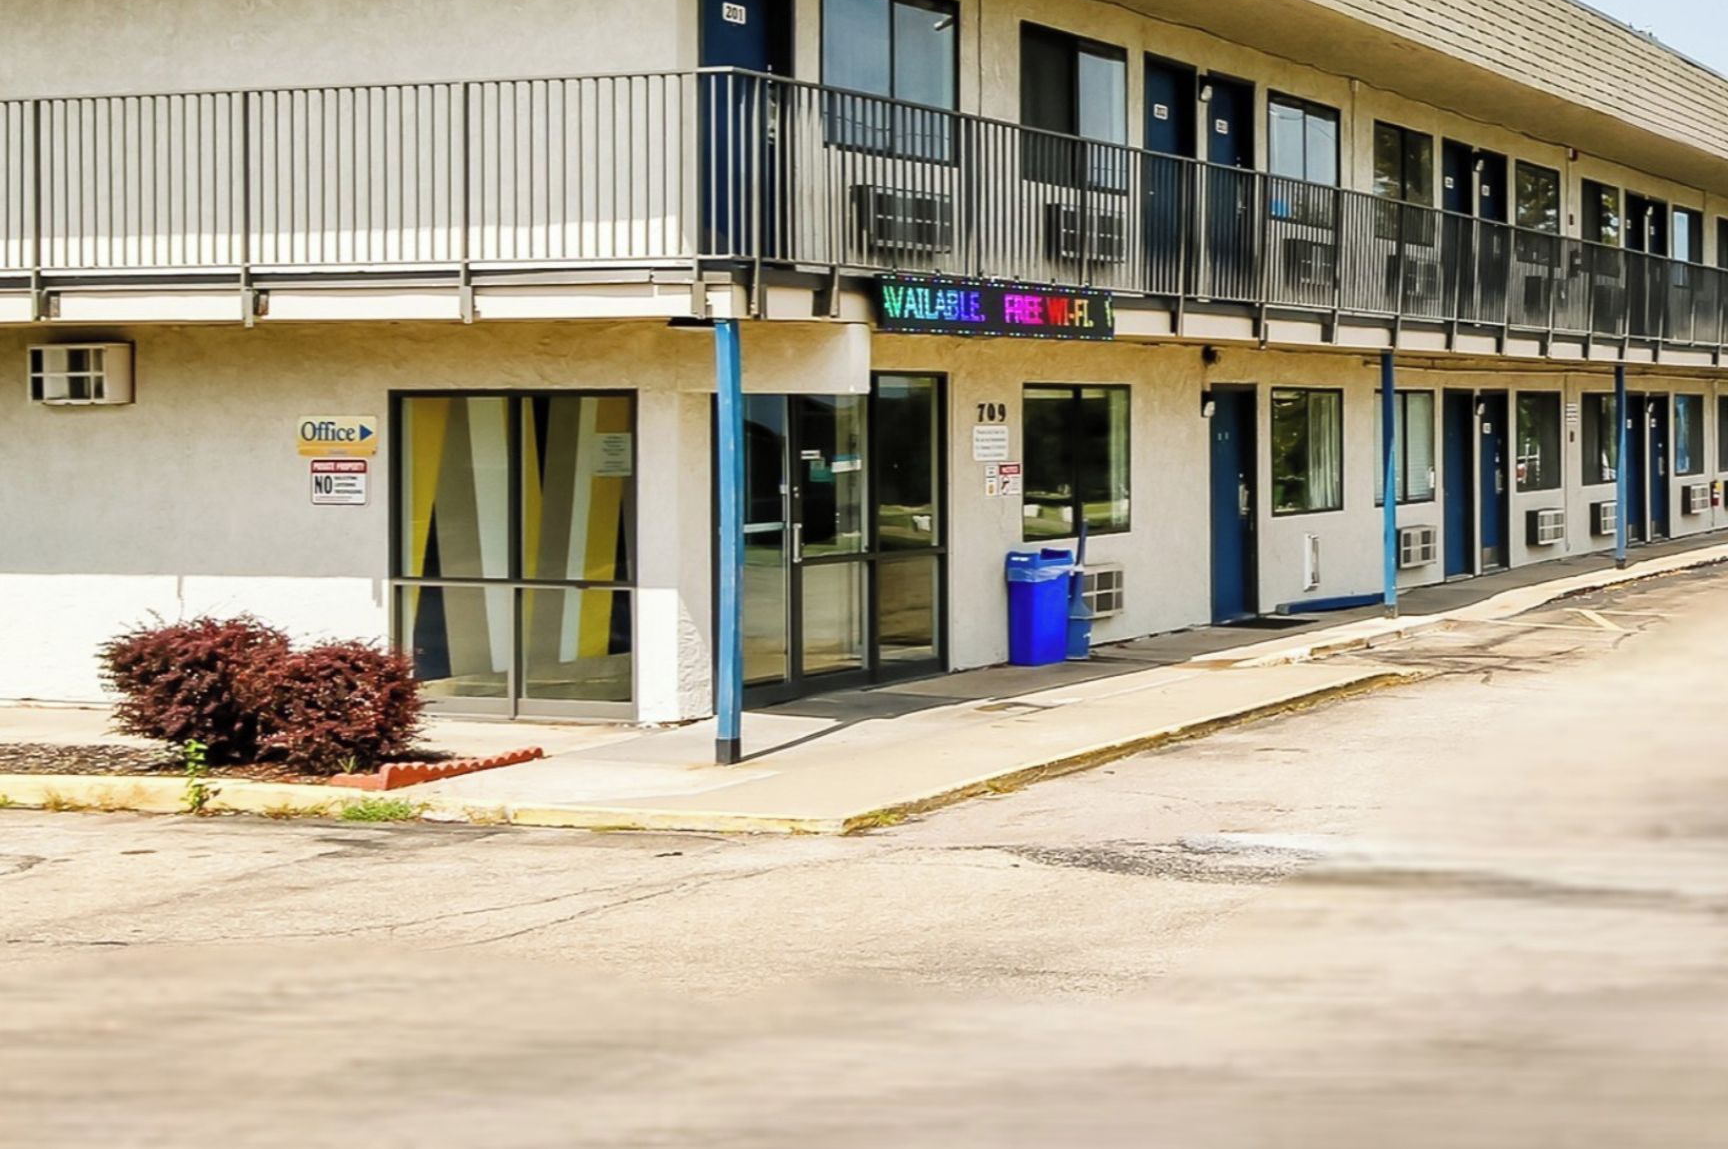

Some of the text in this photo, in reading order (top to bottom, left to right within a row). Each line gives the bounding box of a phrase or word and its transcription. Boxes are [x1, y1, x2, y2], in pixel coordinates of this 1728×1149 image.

[1004, 293, 1044, 326] FREE
[976, 403, 1006, 422] 709
[300, 421, 356, 442] Office
[314, 475, 333, 494] NO
